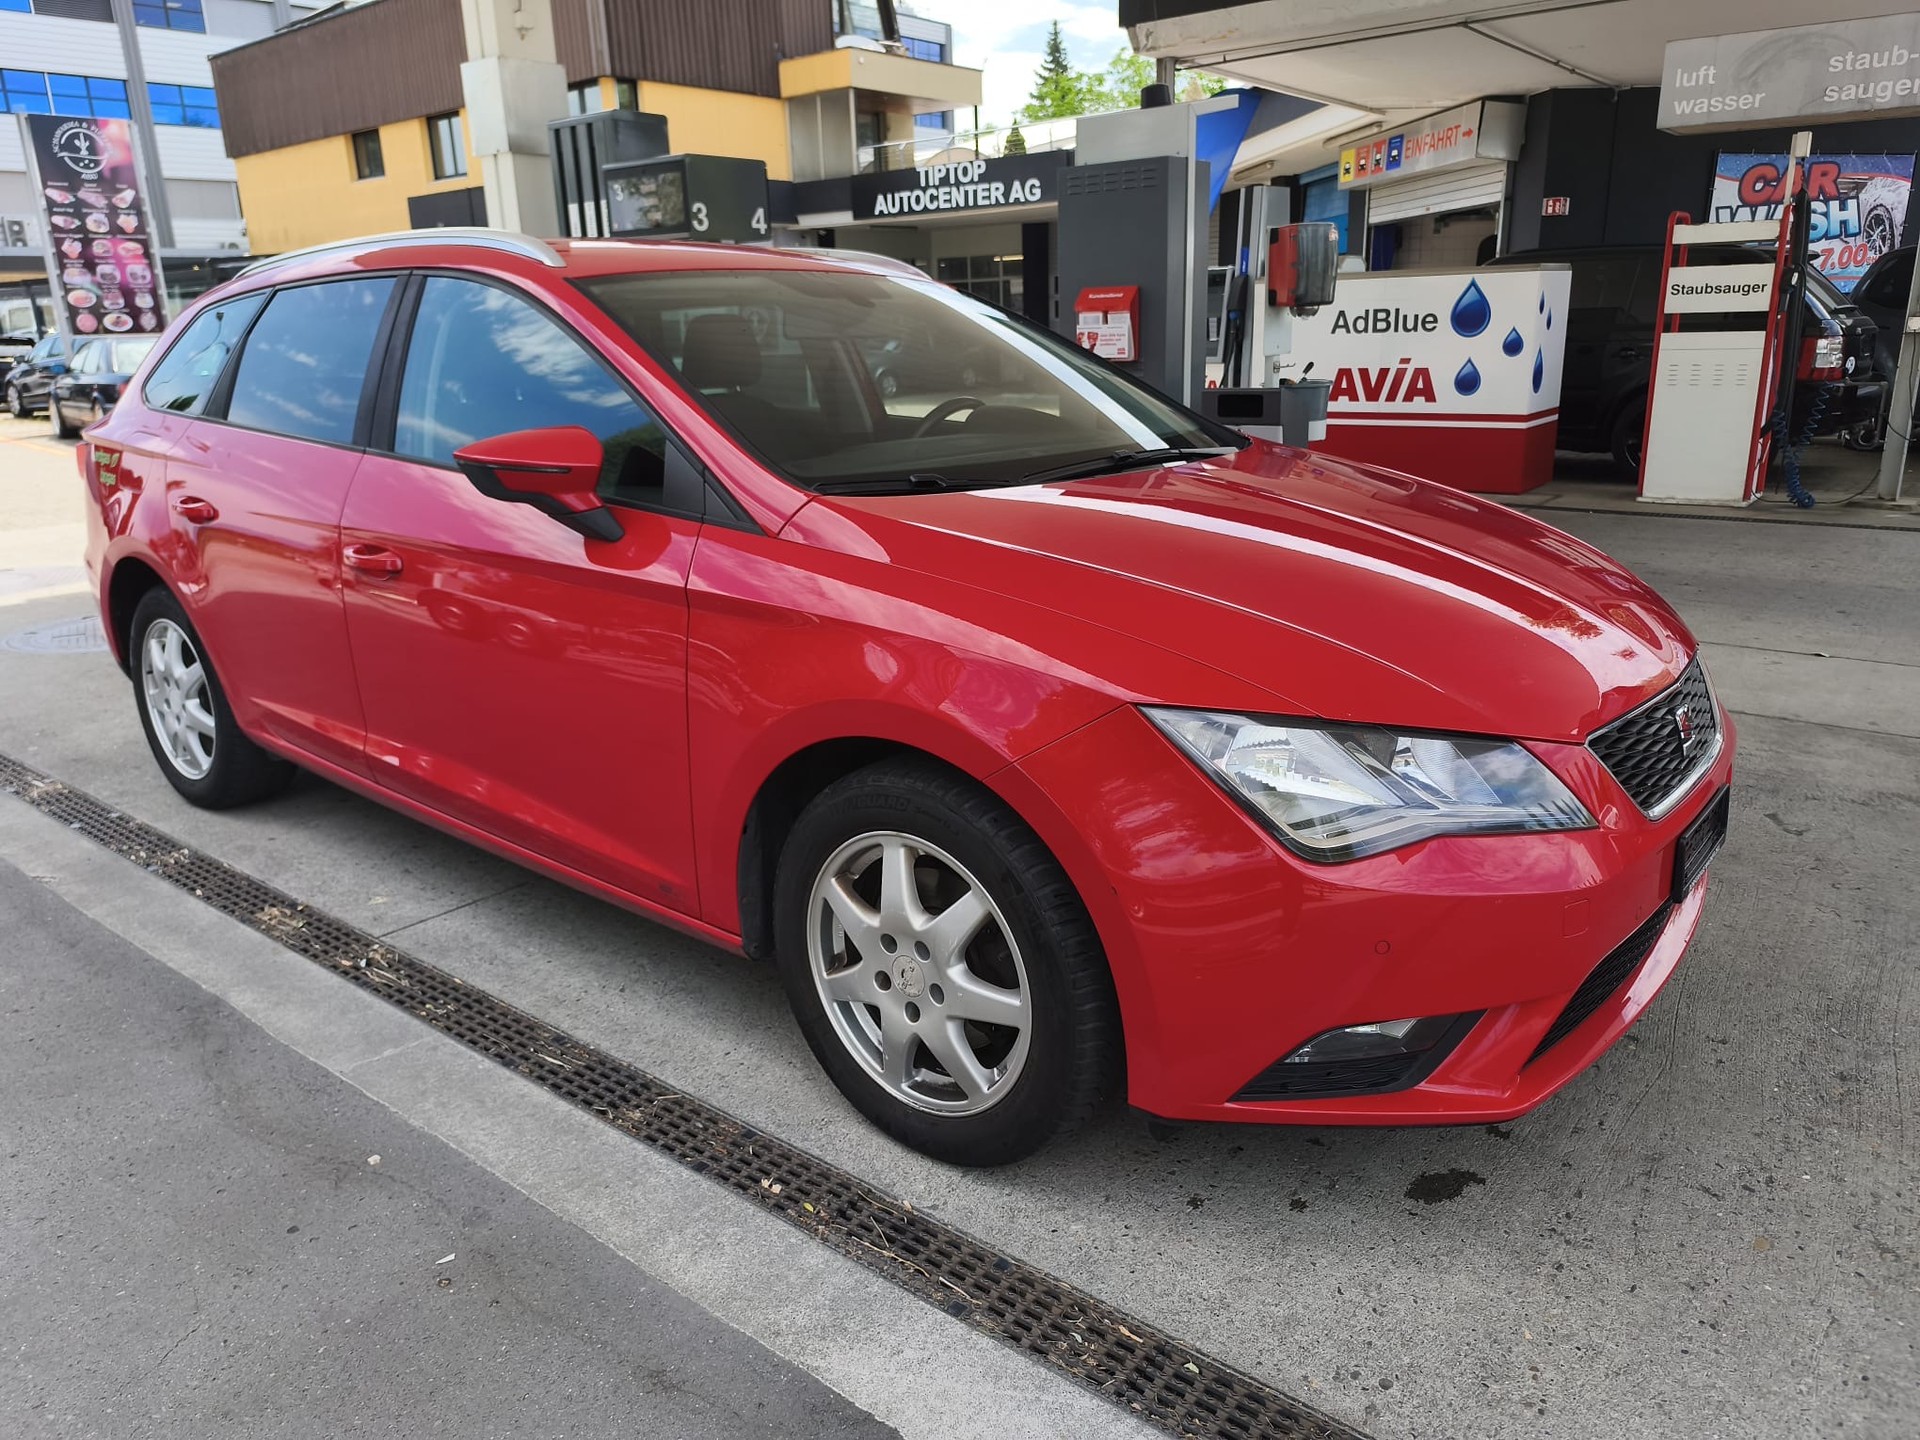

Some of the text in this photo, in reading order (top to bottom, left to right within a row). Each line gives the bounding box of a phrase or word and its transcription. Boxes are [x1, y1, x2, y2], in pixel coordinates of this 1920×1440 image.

[1828, 44, 1920, 72] staub-
[1675, 65, 1717, 88] luft
[1823, 78, 1920, 102] sauger
[1674, 90, 1766, 115] wasser
[1404, 124, 1461, 160] EINFAHRT
[916, 160, 987, 187] TIPTOP
[1738, 161, 1841, 206] CAR
[613, 184, 624, 201] 3
[874, 177, 1042, 215] AUTOCENTER AG
[691, 202, 709, 232] 3
[751, 207, 768, 234] 4
[1819, 243, 1868, 271] 7.00
[1670, 283, 1768, 296] Staubsauger
[1331, 308, 1438, 334] AdBlue
